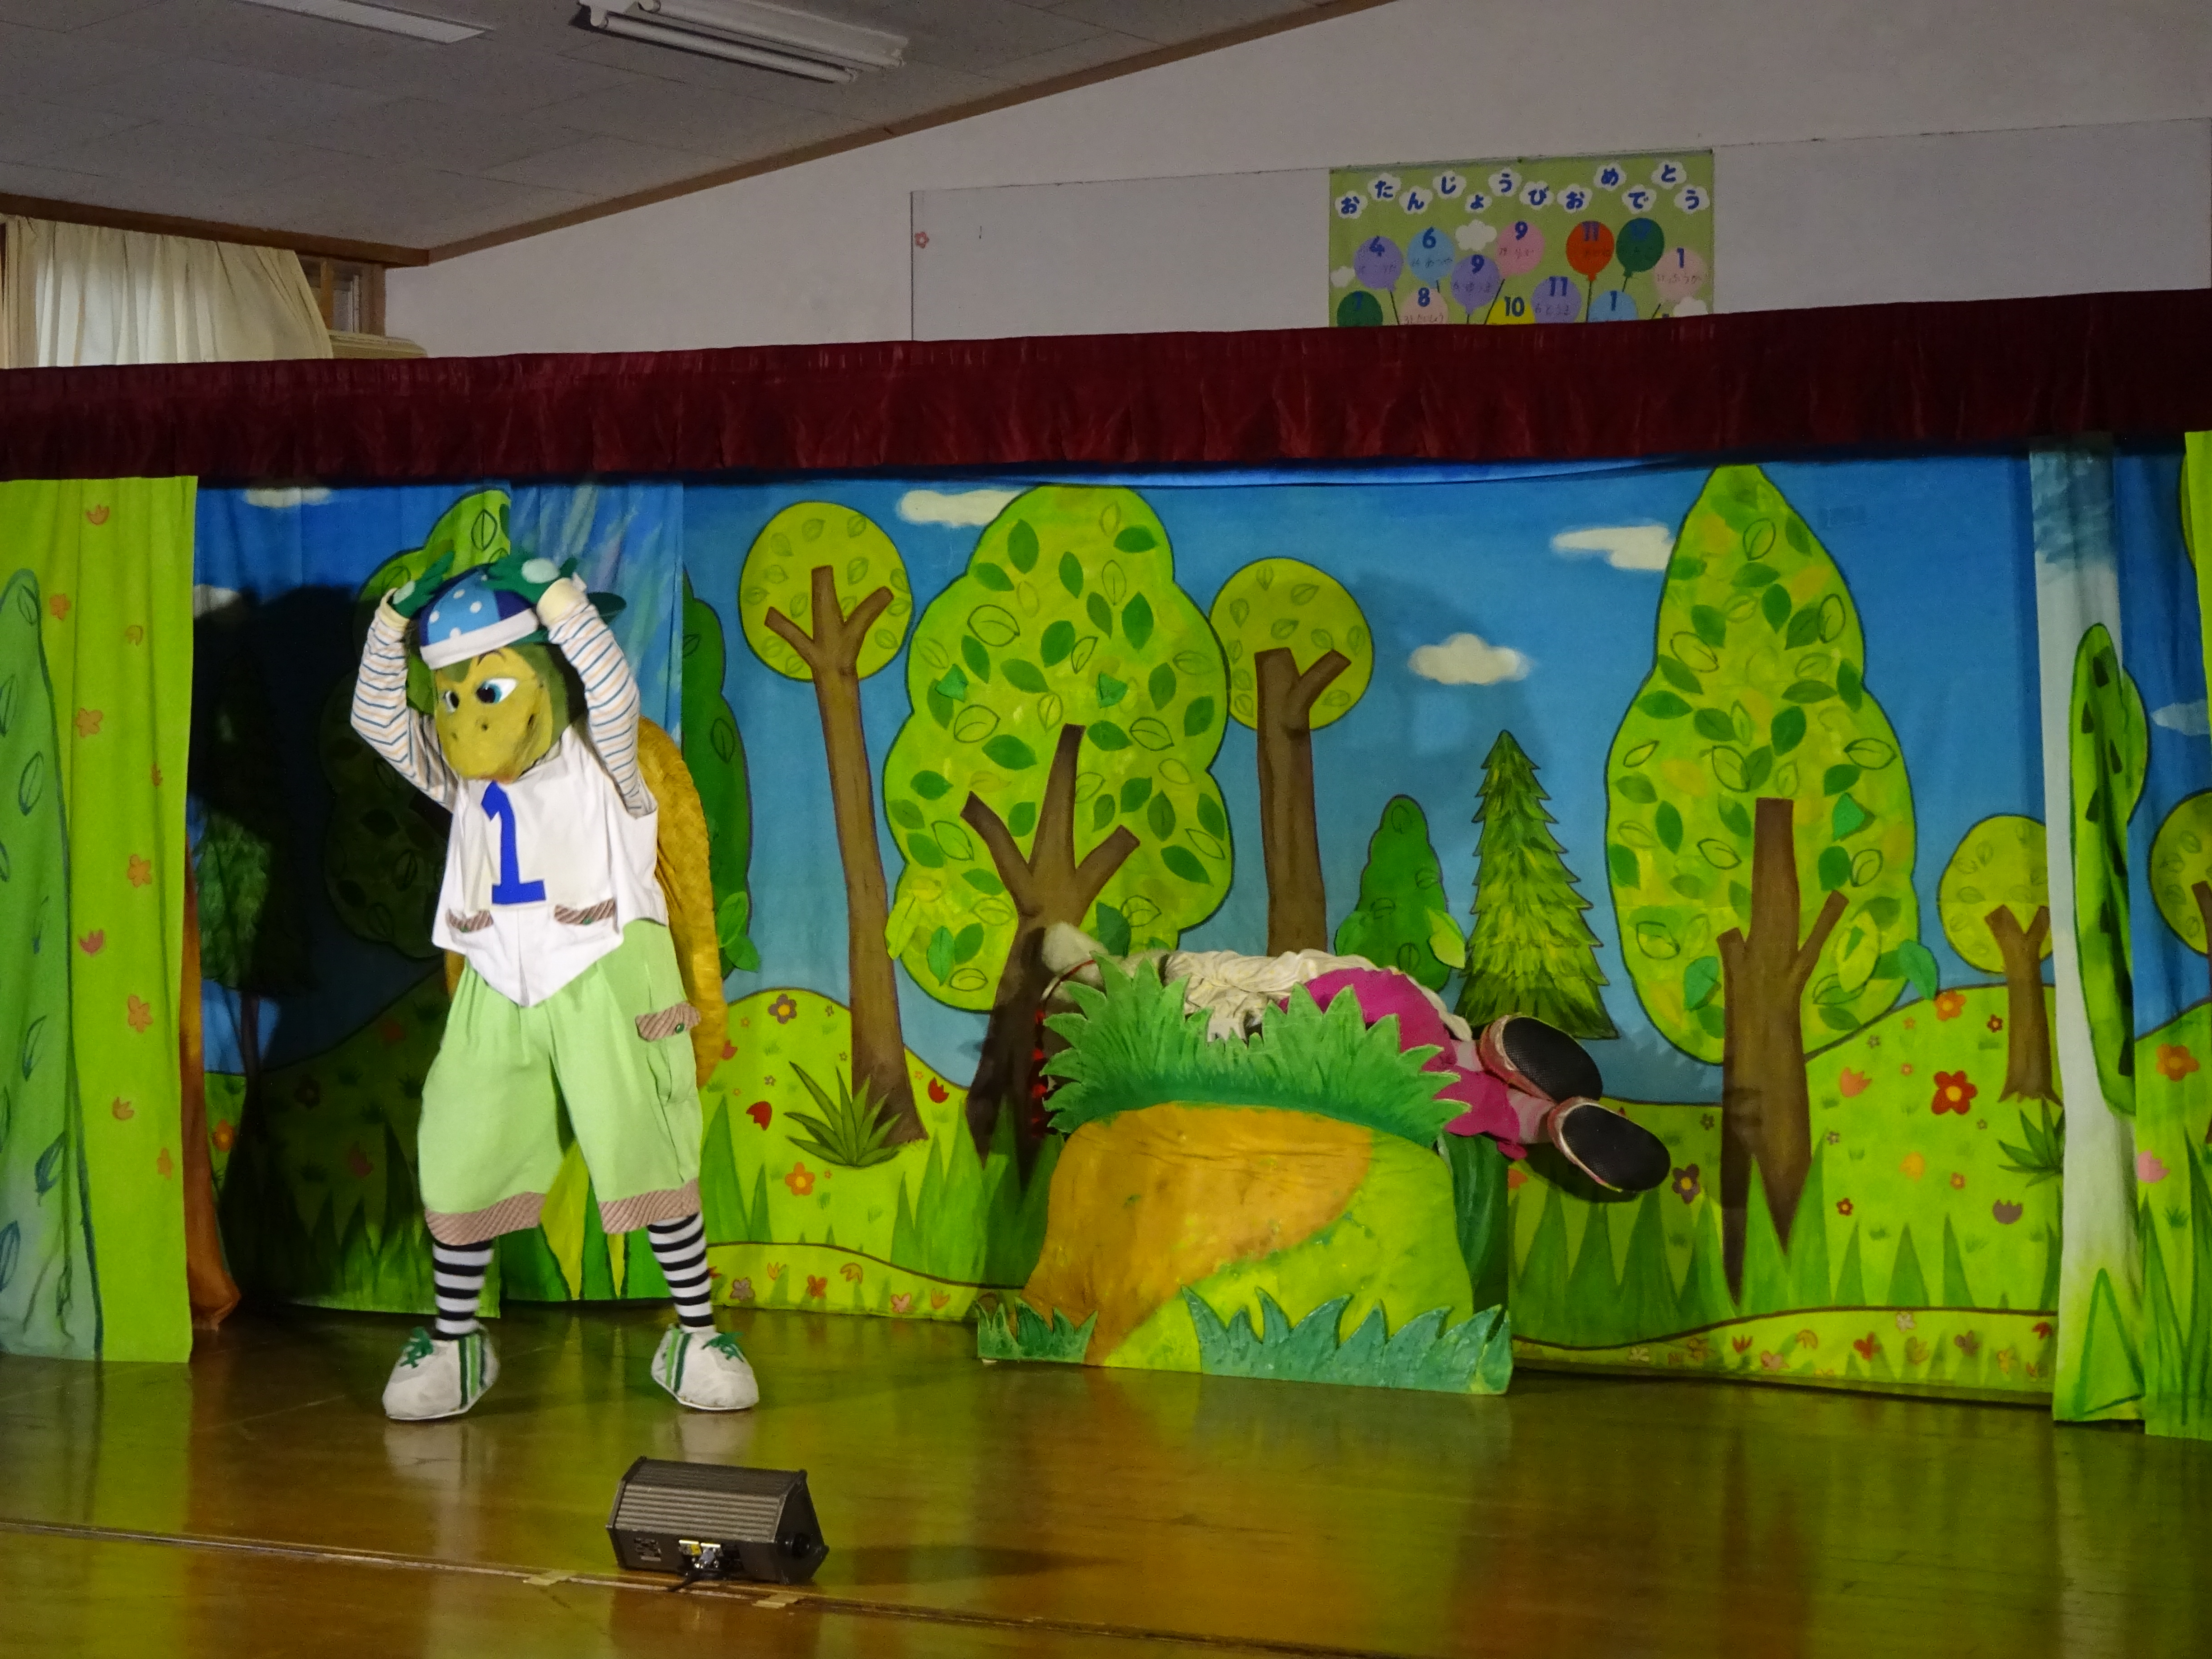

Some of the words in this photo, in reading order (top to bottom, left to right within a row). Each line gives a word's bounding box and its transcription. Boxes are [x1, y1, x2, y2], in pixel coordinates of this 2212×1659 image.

[1341, 164, 1700, 215] おたんじょうびおめでとう
[1422, 227, 1437, 249] 6
[1514, 221, 1528, 241] 9
[1582, 220, 1600, 242] 11
[1368, 235, 1385, 258] 4
[1471, 254, 1485, 274] 9
[1677, 247, 1685, 269] 1
[1417, 287, 1431, 307] 8
[1549, 276, 1568, 297] 11
[1504, 296, 1525, 317] 10
[1609, 290, 1618, 312] 1
[481, 779, 546, 905] 1
